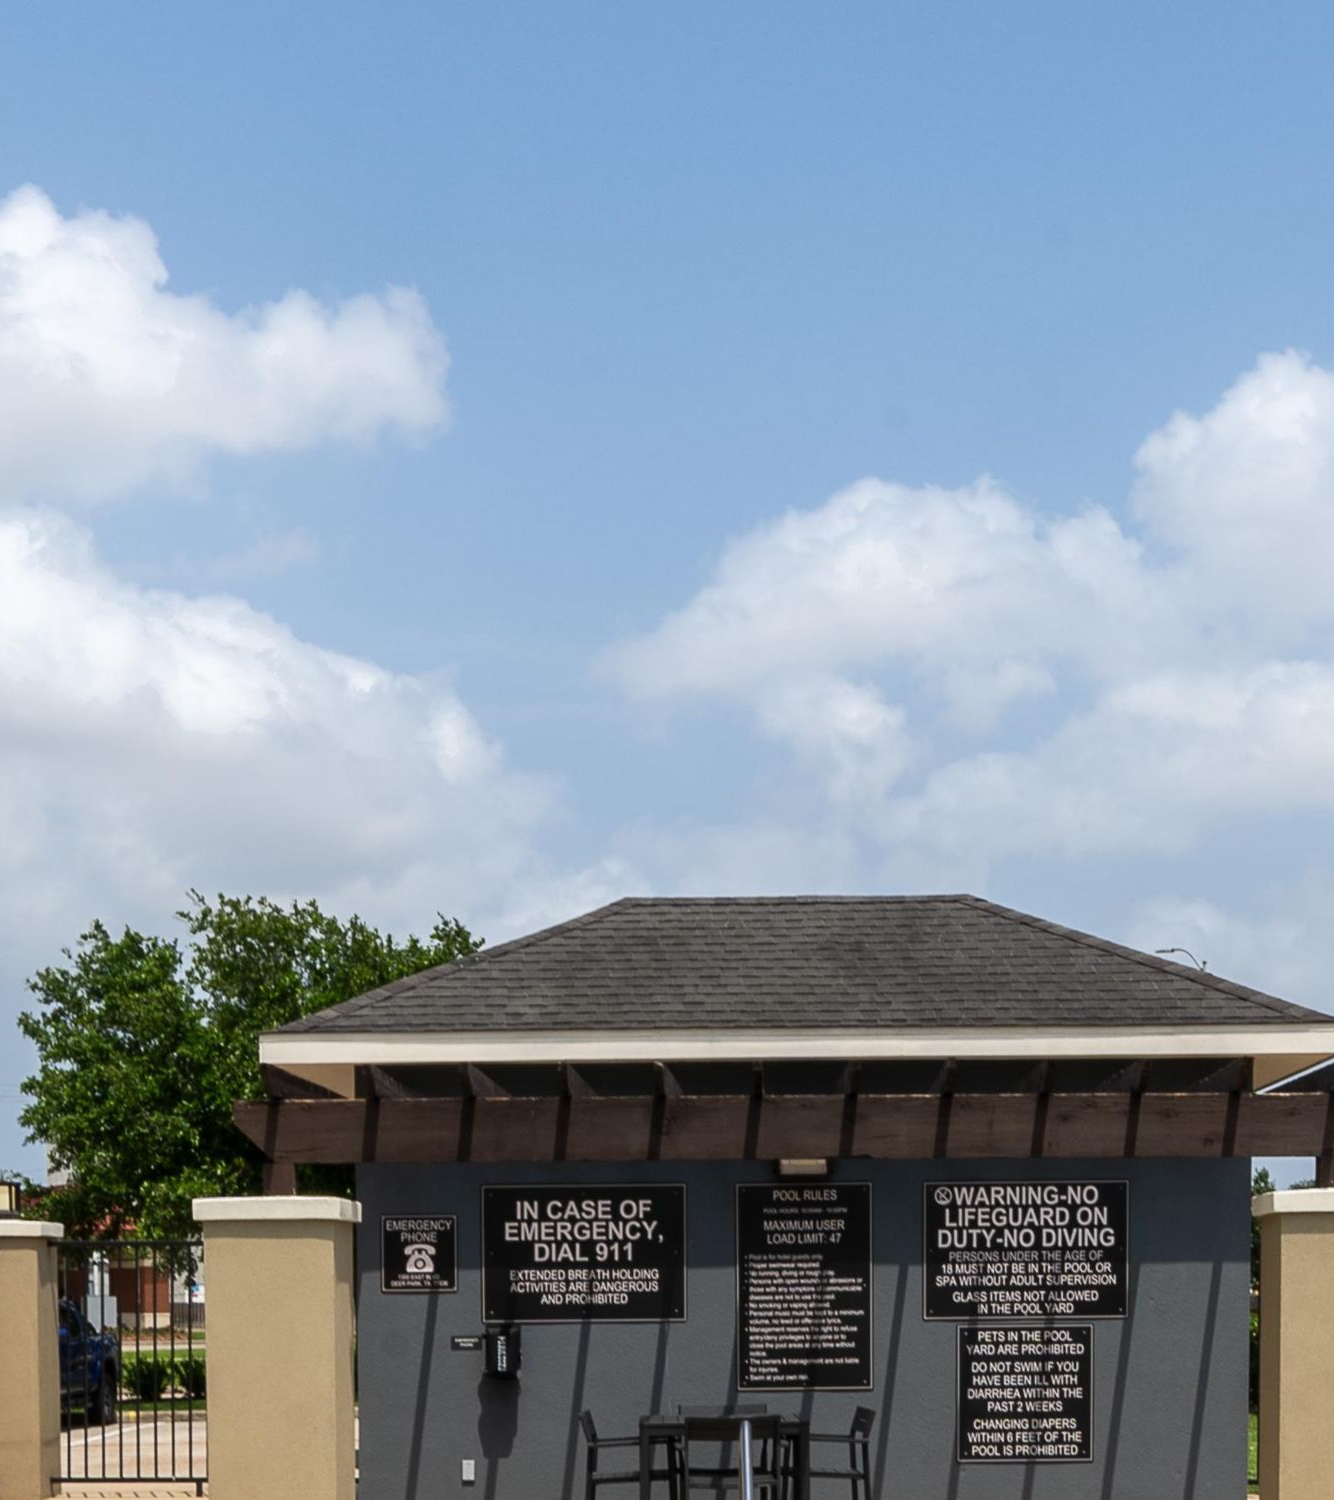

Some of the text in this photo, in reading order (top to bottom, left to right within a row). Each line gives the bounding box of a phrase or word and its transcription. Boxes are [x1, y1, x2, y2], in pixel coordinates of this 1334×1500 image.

[773, 1189, 837, 1201] POOL RULES
[954, 1186, 1098, 1205] WARNING-NO
[516, 1200, 652, 1220] IN CASE OF
[945, 1206, 1107, 1227] LIFEGUARD ON
[386, 1220, 452, 1231] EMERGENCY
[763, 1220, 845, 1231] MAXIMUM USER
[401, 1231, 437, 1243] PHONE
[505, 1221, 663, 1243] EMERGENCY,
[767, 1233, 841, 1244] LOAD LIMIT: 47
[938, 1228, 1115, 1248] DUTY-NO DIVING
[534, 1242, 633, 1262] DIAL 911
[949, 1251, 1103, 1262] PERSONS UNDER THE AGE OF
[942, 1263, 1111, 1274] 18 MUST NOT BE IN THE POOL OR
[510, 1269, 659, 1281] EXTENDED BREATH HOLDING
[936, 1275, 1117, 1286] SPA WITHOUT ADULT SUPERVISION
[510, 1281, 659, 1292] ACTIVITIES ARE DANGEROUS
[541, 1293, 628, 1305] AND PROHIBITED
[952, 1291, 1099, 1303] GLASS ITEMS NOT ALLOWED
[978, 1303, 1074, 1314] IN THE POOL YARD
[978, 1330, 1072, 1341] PETS IN THE POOL
[967, 1344, 1085, 1355] YARD ARE PROHIBITED
[971, 1362, 1079, 1373] DO NOT SWIM IF YOU
[973, 1375, 1078, 1386] HAVE BEEN ILL WITH
[967, 1388, 1083, 1399] DIARRHEA WITHIN THE
[987, 1401, 1063, 1412] PAST 2 WEEKS
[973, 1418, 1076, 1430] CHANGING DIAPERS
[967, 1432, 1082, 1443] WITHIN 6 FEET OF THE
[972, 1445, 1078, 1456] POOL IS PROHIBITED
